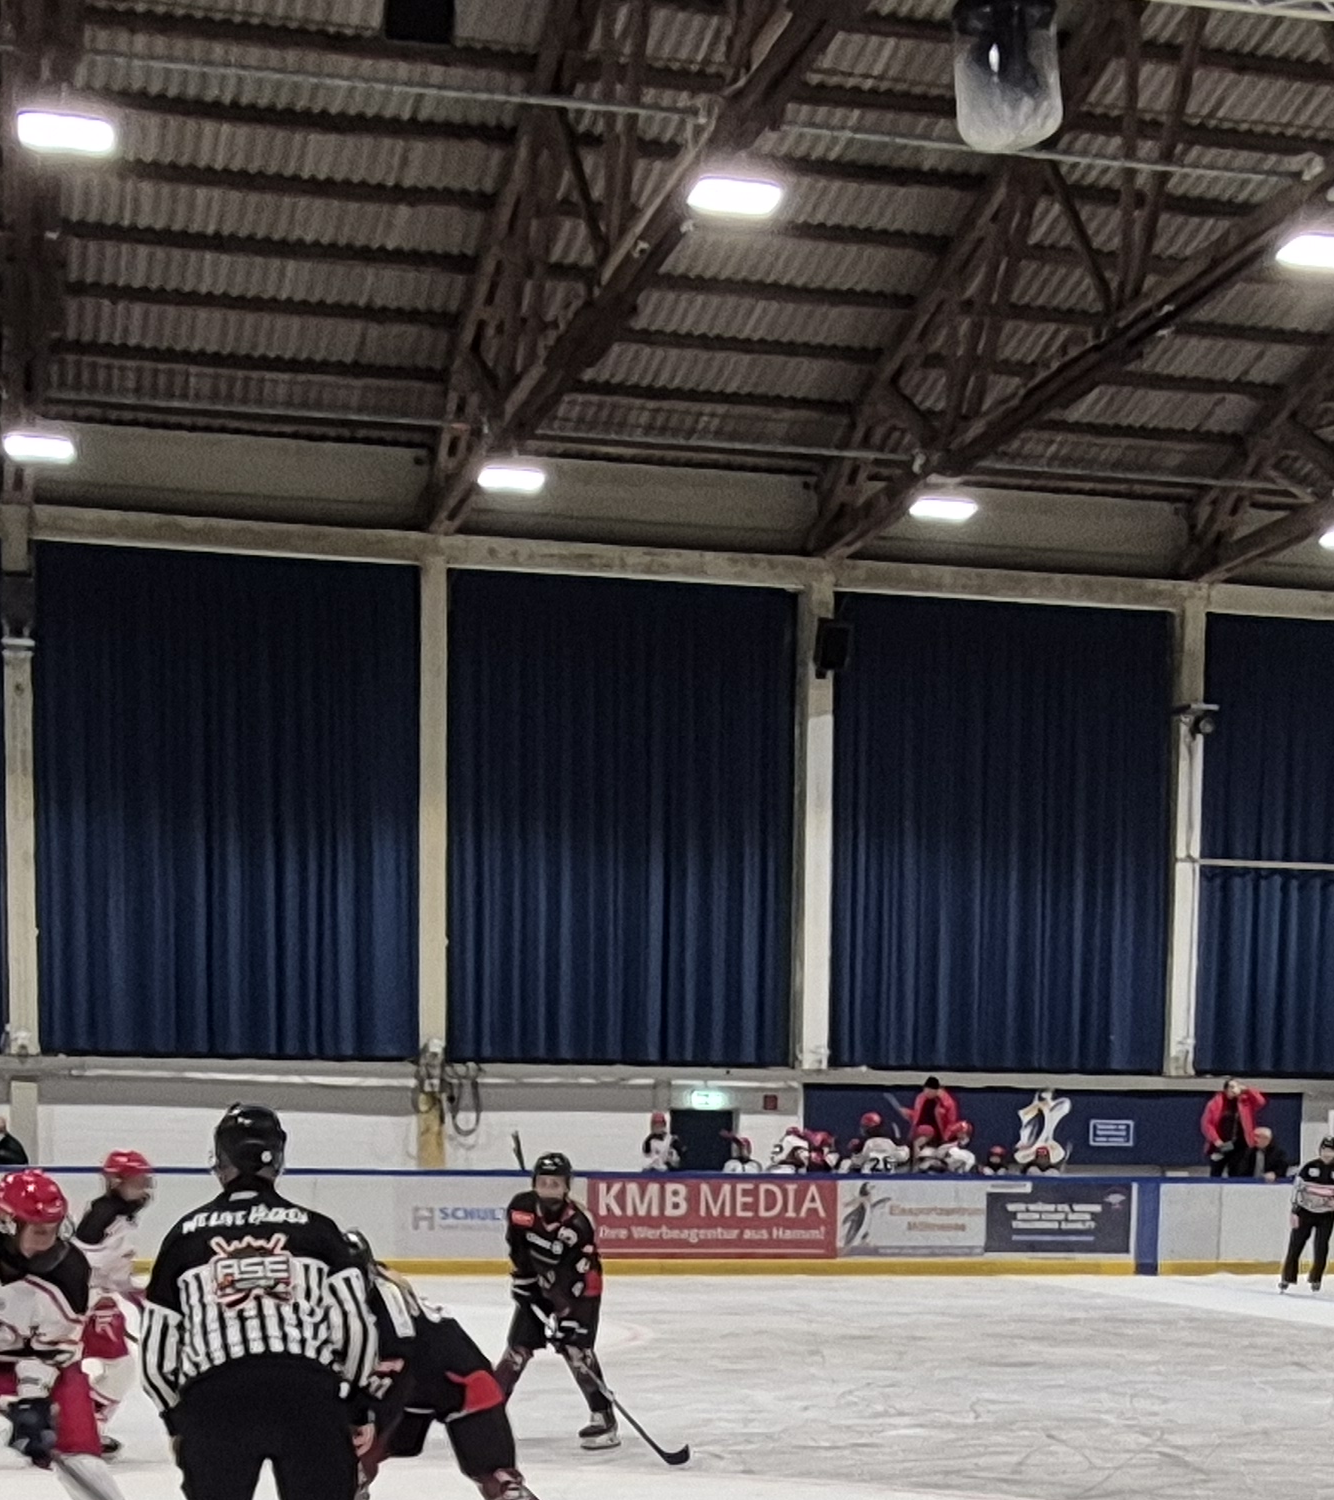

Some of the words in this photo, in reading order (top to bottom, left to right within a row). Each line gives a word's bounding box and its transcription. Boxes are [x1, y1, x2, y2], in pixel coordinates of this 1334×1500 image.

[597, 1182, 688, 1218] KMB
[699, 1183, 827, 1218] MEDIA
[599, 1225, 629, 1239] Ihre
[631, 1224, 739, 1242] Werbeagentur
[743, 1228, 768, 1240] aus
[773, 1225, 826, 1240] Hamm!
